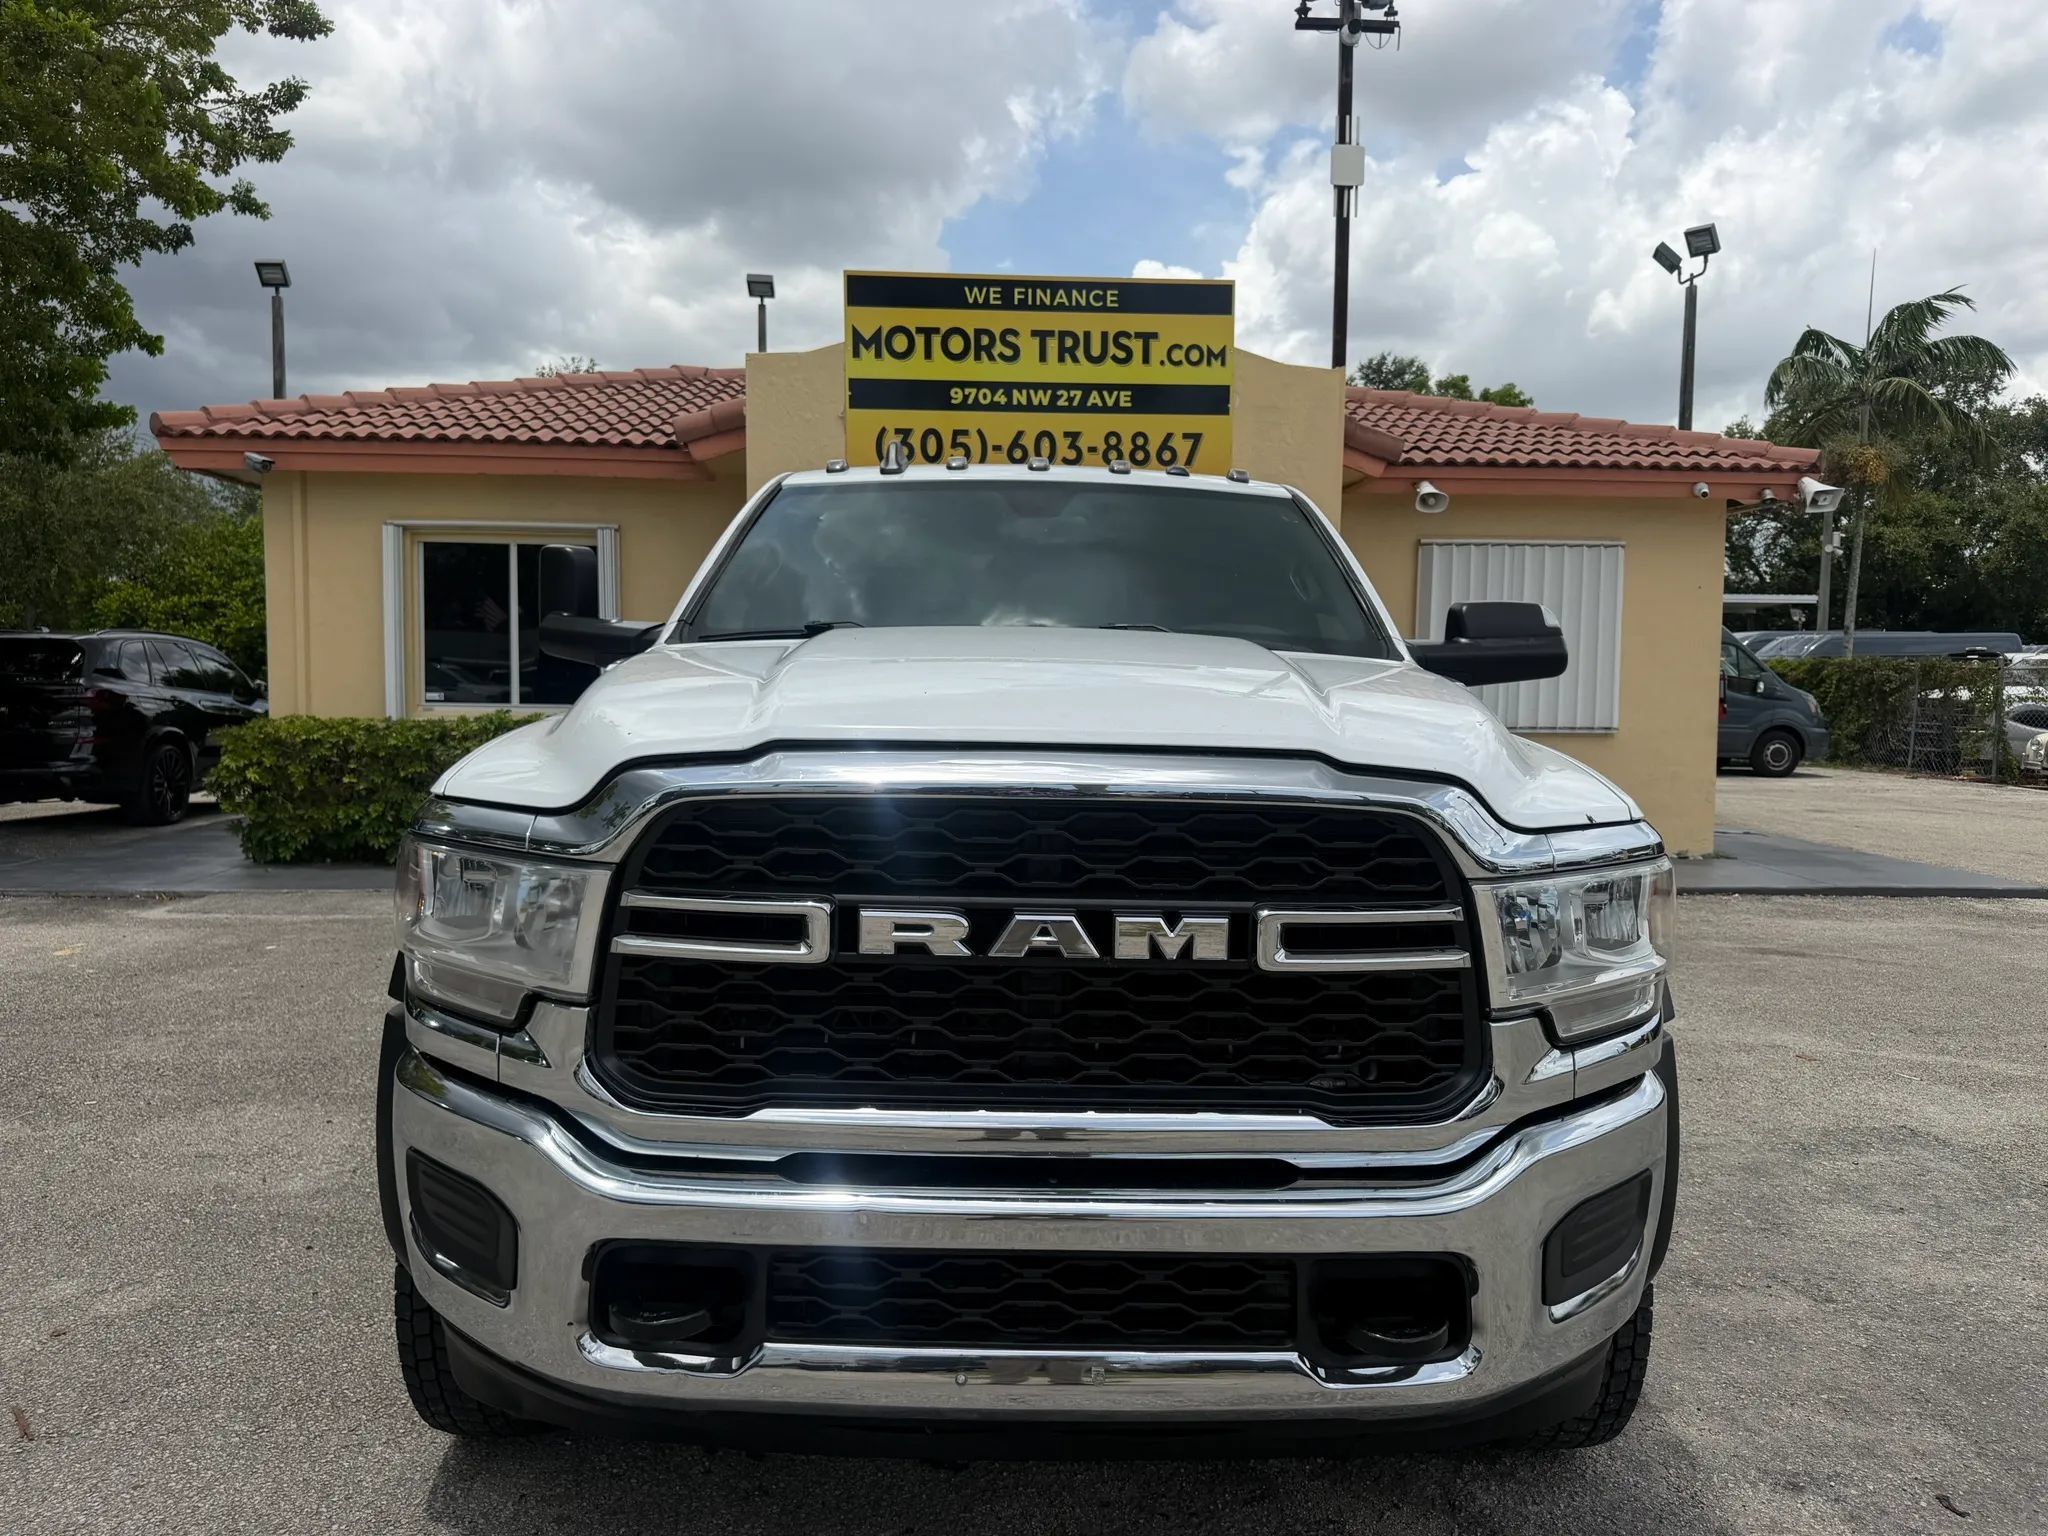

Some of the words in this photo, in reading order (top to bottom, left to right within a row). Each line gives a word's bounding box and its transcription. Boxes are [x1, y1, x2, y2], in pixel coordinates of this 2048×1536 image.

[964, 286, 1002, 305] WE
[1014, 287, 1119, 308] FINANCE
[851, 324, 1021, 365] MOTORS
[949, 387, 1007, 406] 9704
[1012, 389, 1053, 407] NW
[1057, 389, 1081, 407] 27
[1086, 390, 1132, 408] AVE
[875, 425, 1204, 467] (305)-603-8867
[858, 909, 1230, 961] RAM
